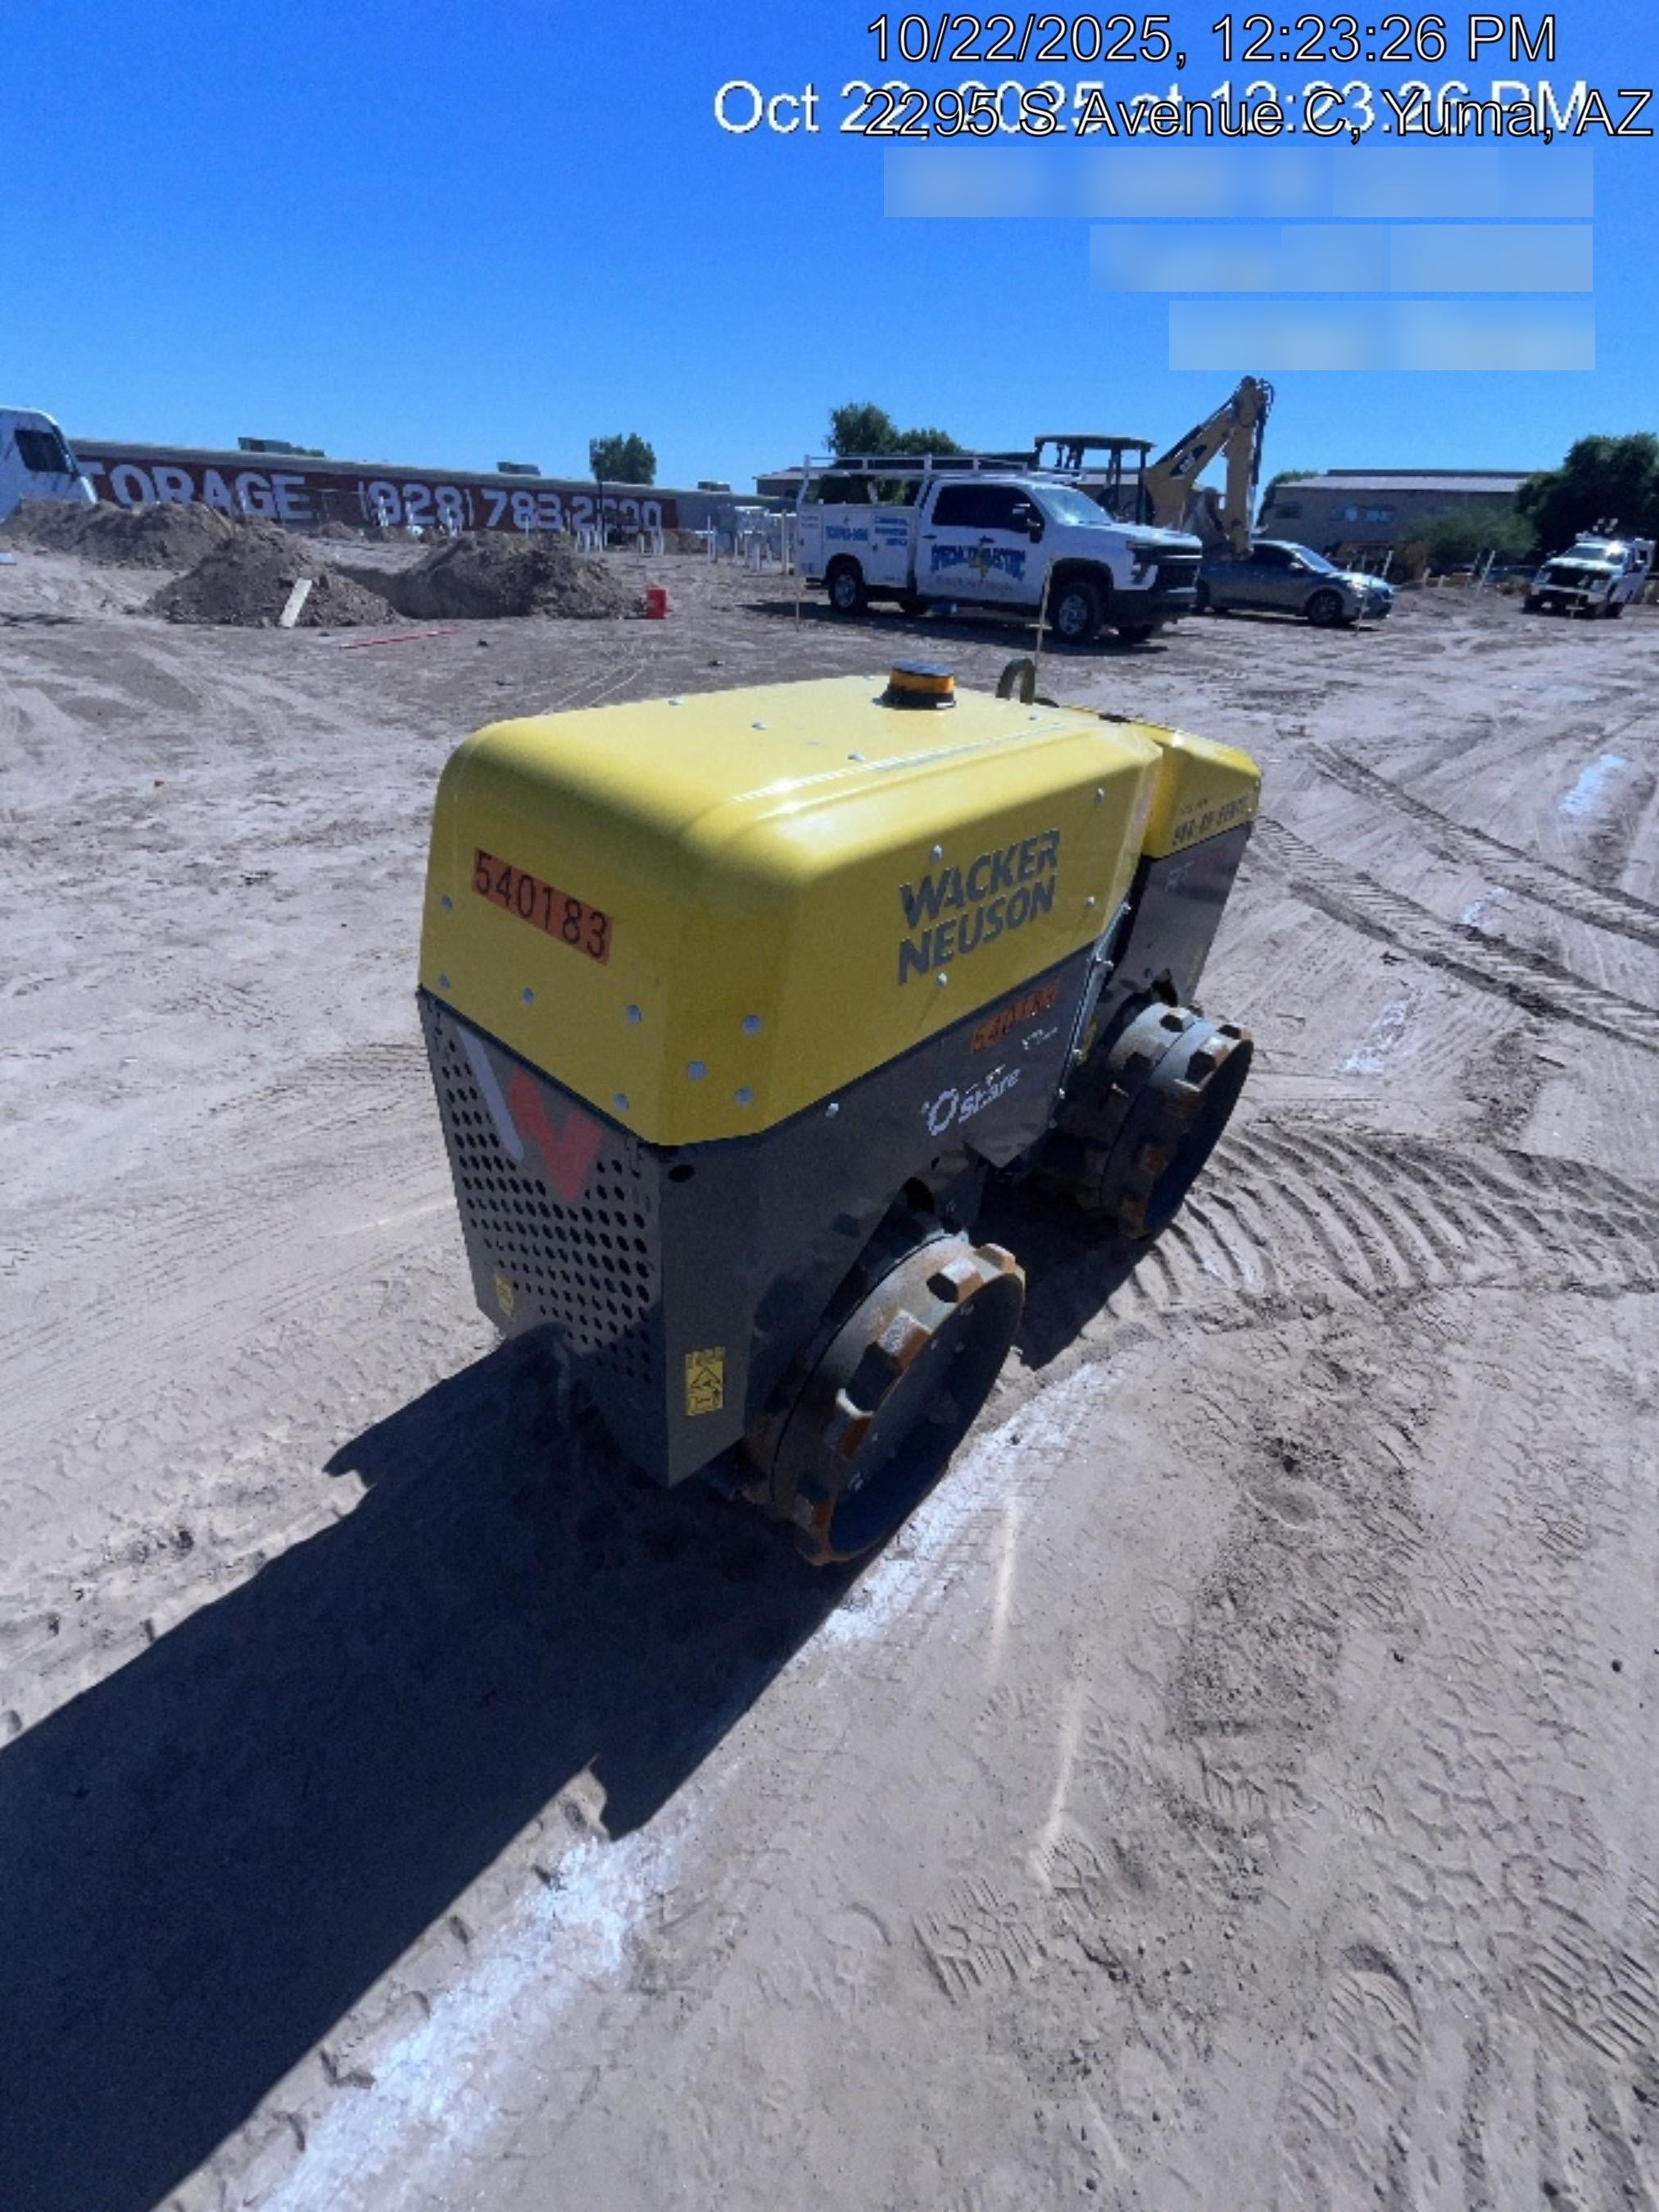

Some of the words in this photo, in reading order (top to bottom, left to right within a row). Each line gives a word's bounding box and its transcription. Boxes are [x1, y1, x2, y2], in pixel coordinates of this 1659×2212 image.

[80, 461, 313, 519] TORAGE
[359, 480, 475, 526] (928)
[476, 850, 607, 958] 540183
[898, 873, 1057, 986] NEUSON
[900, 828, 1059, 929] WACKER
